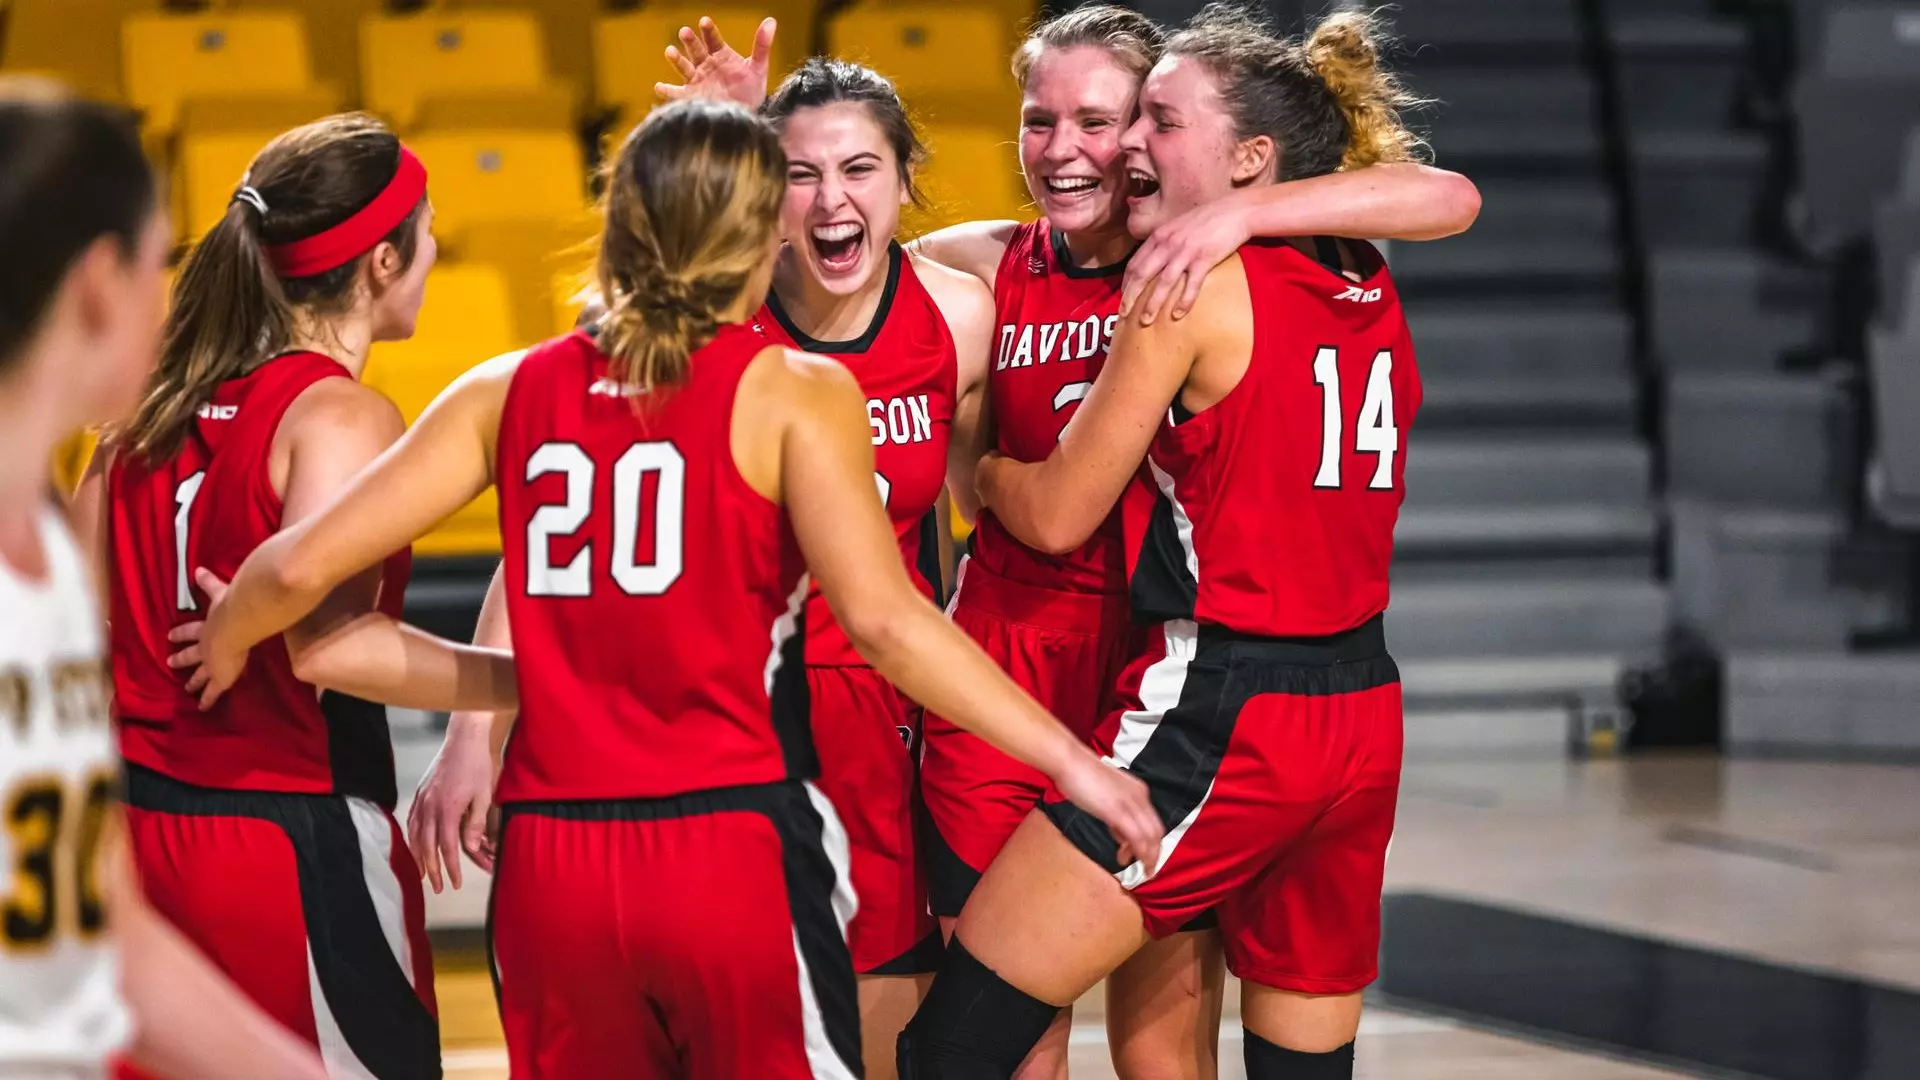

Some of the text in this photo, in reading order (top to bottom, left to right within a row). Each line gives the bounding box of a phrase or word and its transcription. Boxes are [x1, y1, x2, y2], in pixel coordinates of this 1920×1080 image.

[1332, 285, 1382, 303] A10
[865, 393, 932, 446] SON
[1311, 345, 1399, 490] 14
[174, 469, 206, 611] 1
[525, 438, 685, 597] 20
